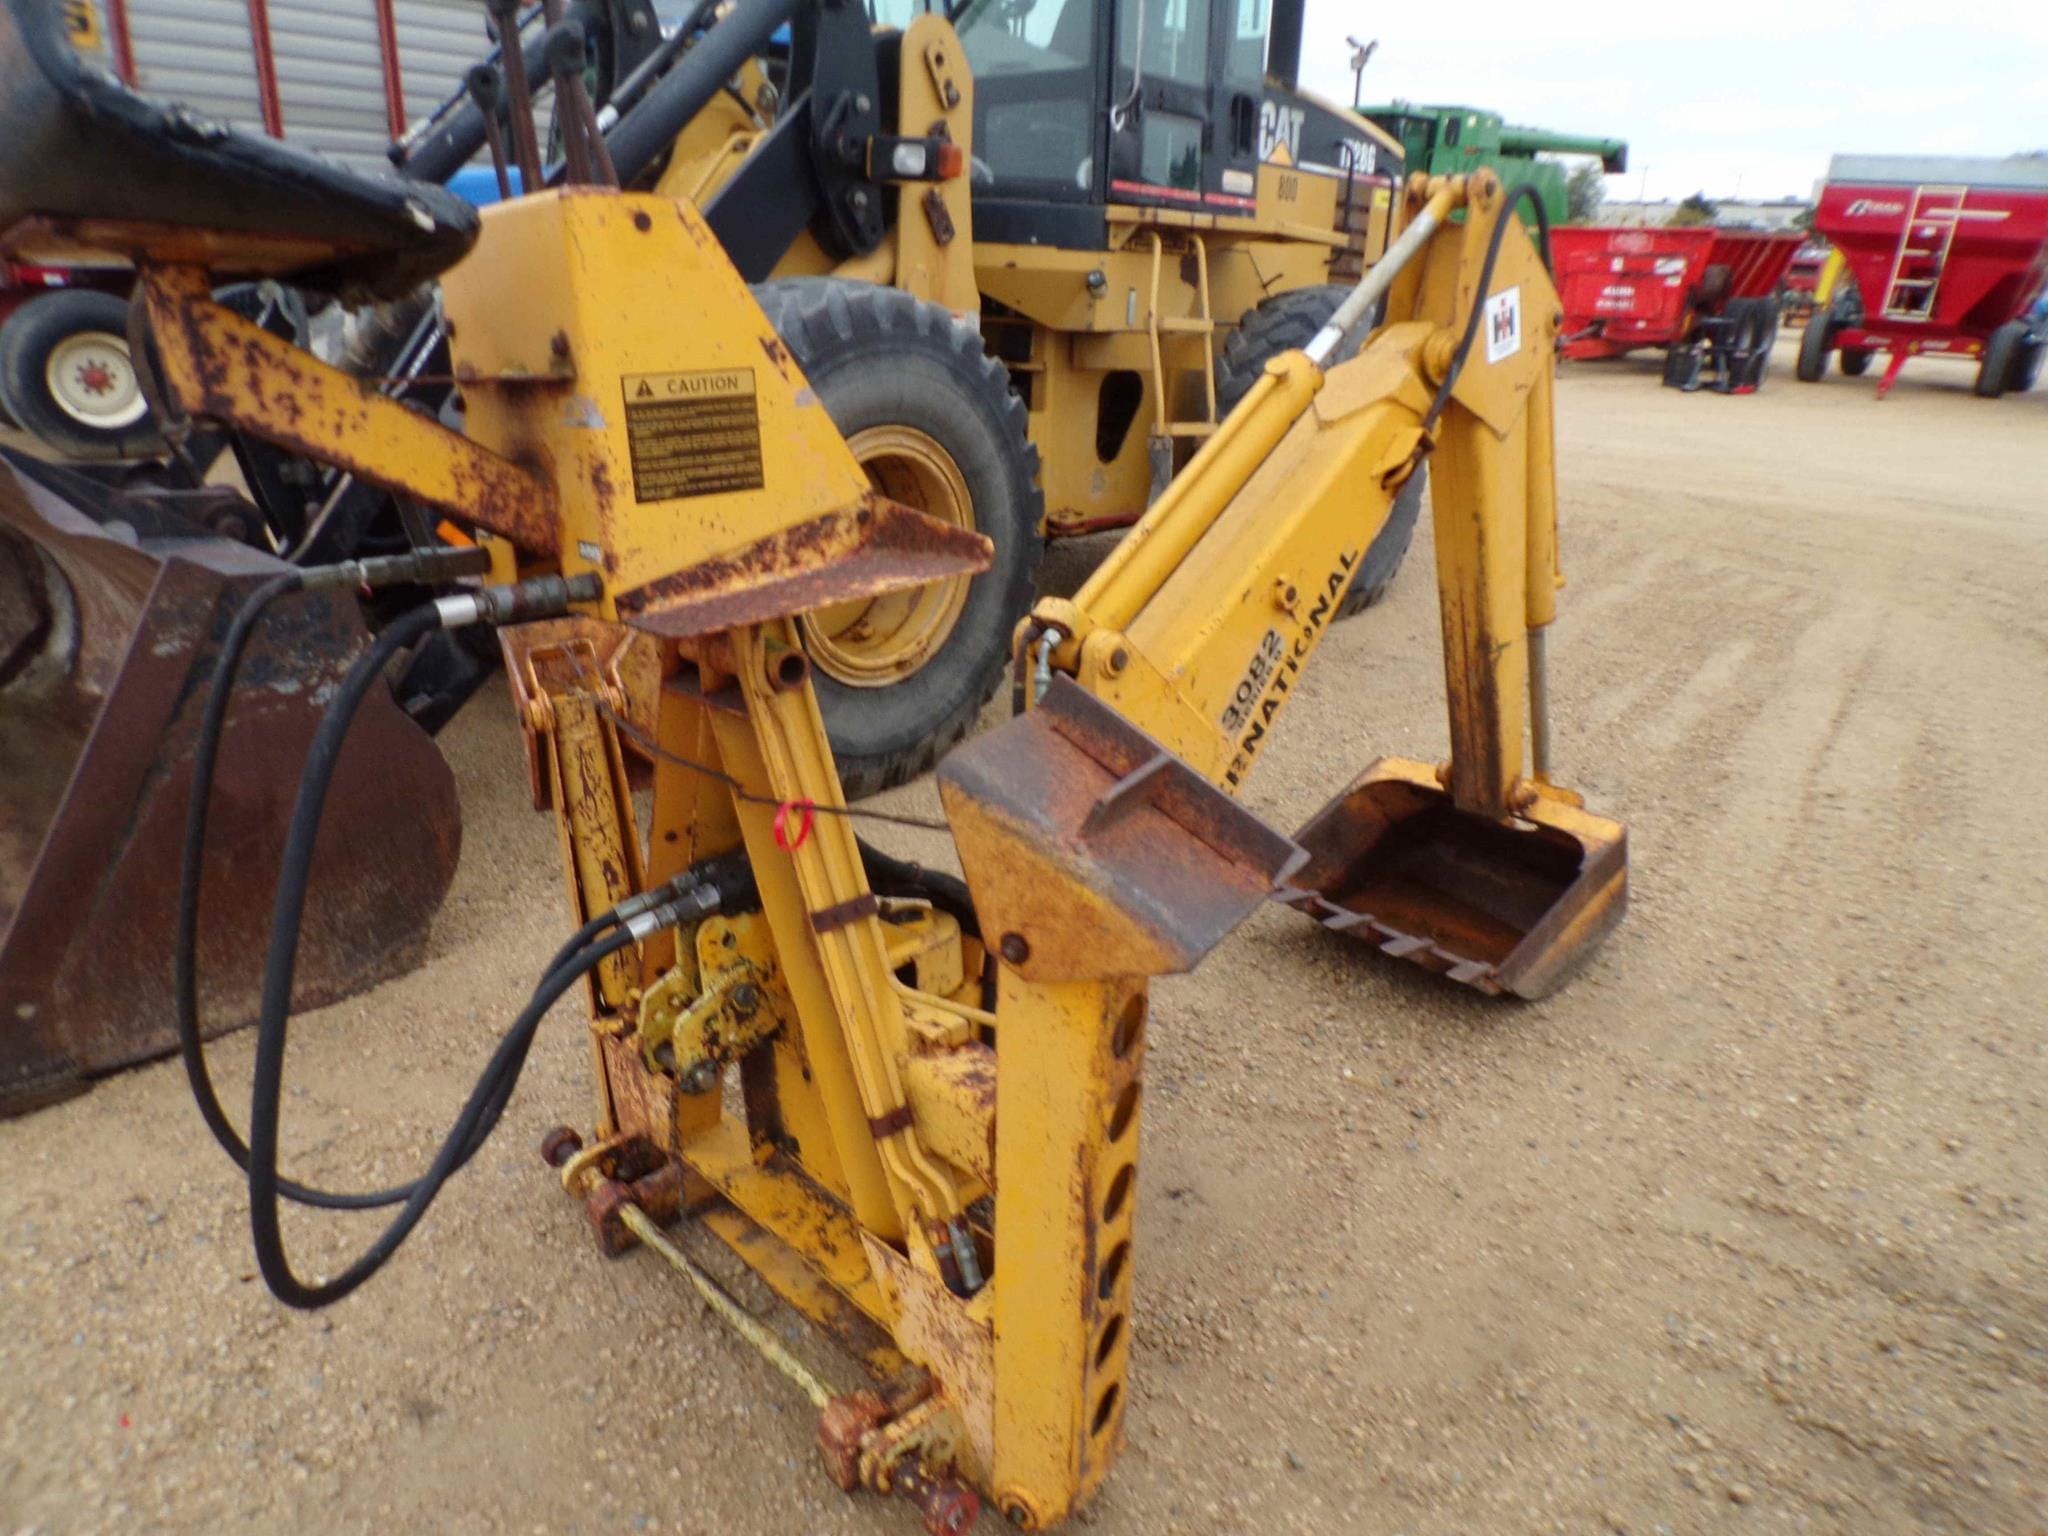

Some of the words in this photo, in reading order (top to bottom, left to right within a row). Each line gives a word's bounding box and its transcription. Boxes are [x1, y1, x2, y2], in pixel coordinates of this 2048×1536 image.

[1258, 100, 1305, 166] CAT
[667, 375, 739, 394] CAUTION
[1221, 629, 1280, 731] 3082
